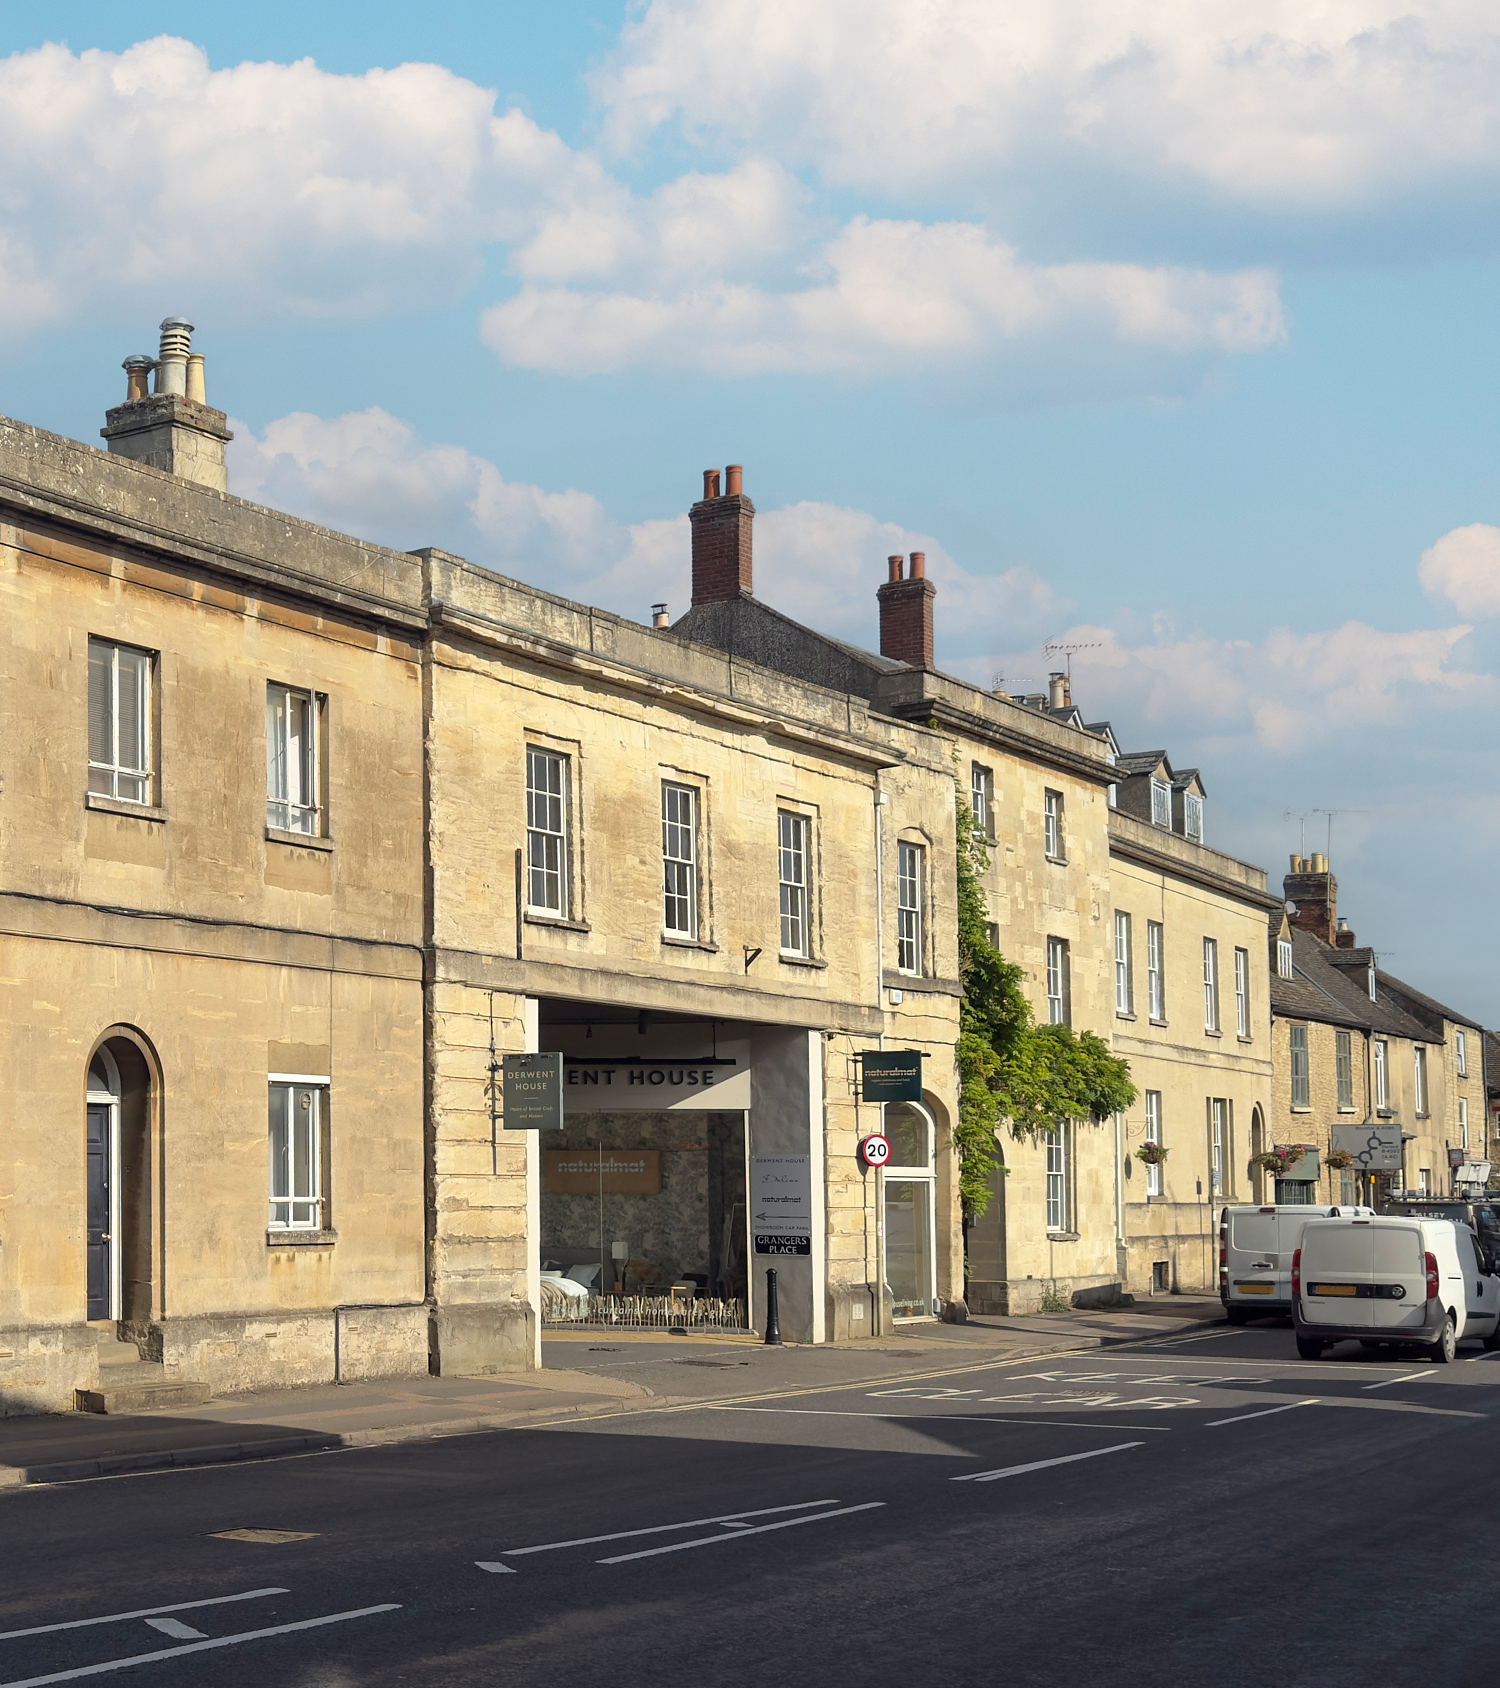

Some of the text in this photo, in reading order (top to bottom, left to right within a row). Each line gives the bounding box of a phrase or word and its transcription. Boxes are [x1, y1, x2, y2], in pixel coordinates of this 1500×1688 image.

[507, 1070, 555, 1079] DERWENT
[865, 1067, 917, 1077] naturalmat
[569, 1070, 715, 1086] ENT HOUSE
[515, 1082, 548, 1090] HOUSE
[867, 1144, 887, 1157] 20
[558, 1157, 645, 1173] naturalmat
[761, 1195, 802, 1203] naturalmat
[757, 1235, 807, 1245] GRANGERS
[769, 1245, 798, 1254] PLACE
[1004, 1371, 1273, 1387] KEEP
[865, 1388, 1202, 1409] CLEAR
